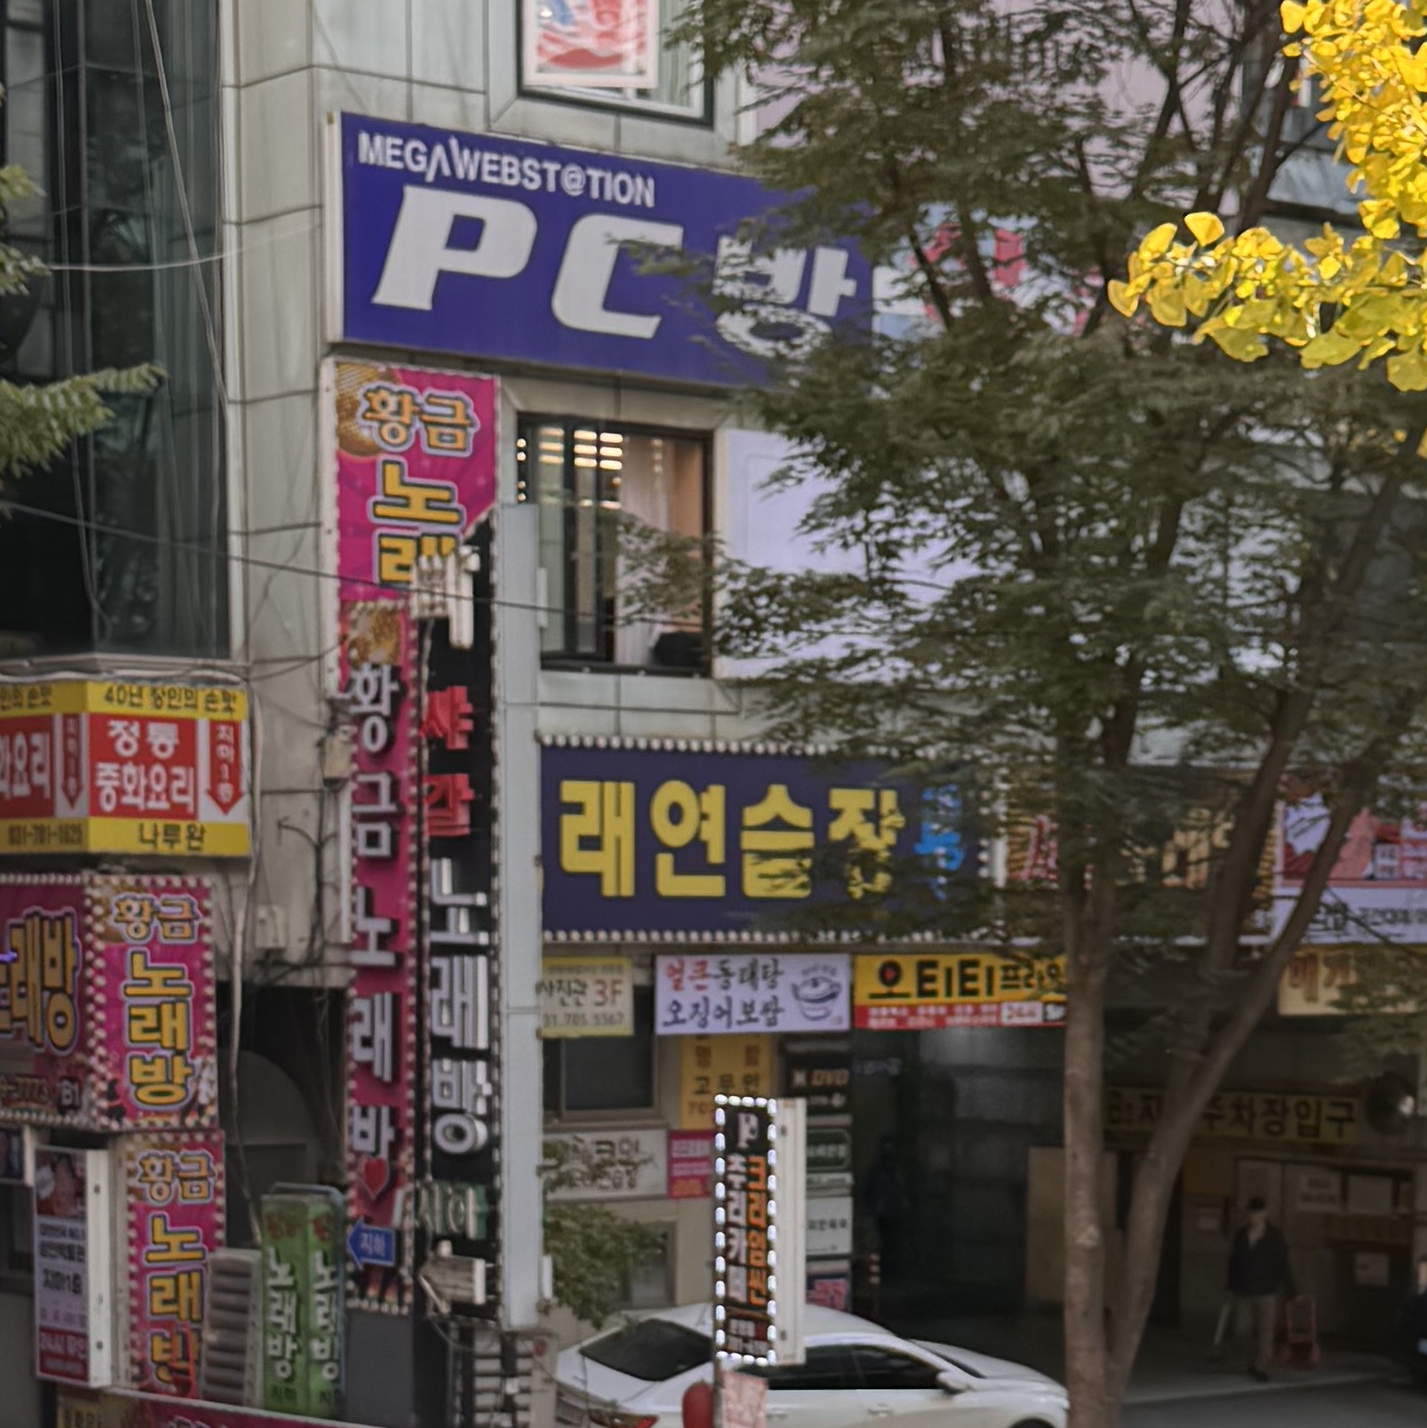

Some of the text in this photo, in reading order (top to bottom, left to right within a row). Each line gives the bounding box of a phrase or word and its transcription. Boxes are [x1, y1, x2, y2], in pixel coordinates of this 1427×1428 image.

[361, 384, 476, 451] 황금
[104, 683, 237, 714] 40년 장인의 손맛
[108, 719, 180, 758] 정통
[94, 761, 195, 814] 중화요리
[139, 822, 206, 851] 나루완
[112, 897, 201, 941] 황금
[429, 857, 490, 1156] 노래방
[593, 978, 623, 1007] 3F
[123, 949, 195, 1106] 노래방
[138, 1152, 215, 1202] 황금
